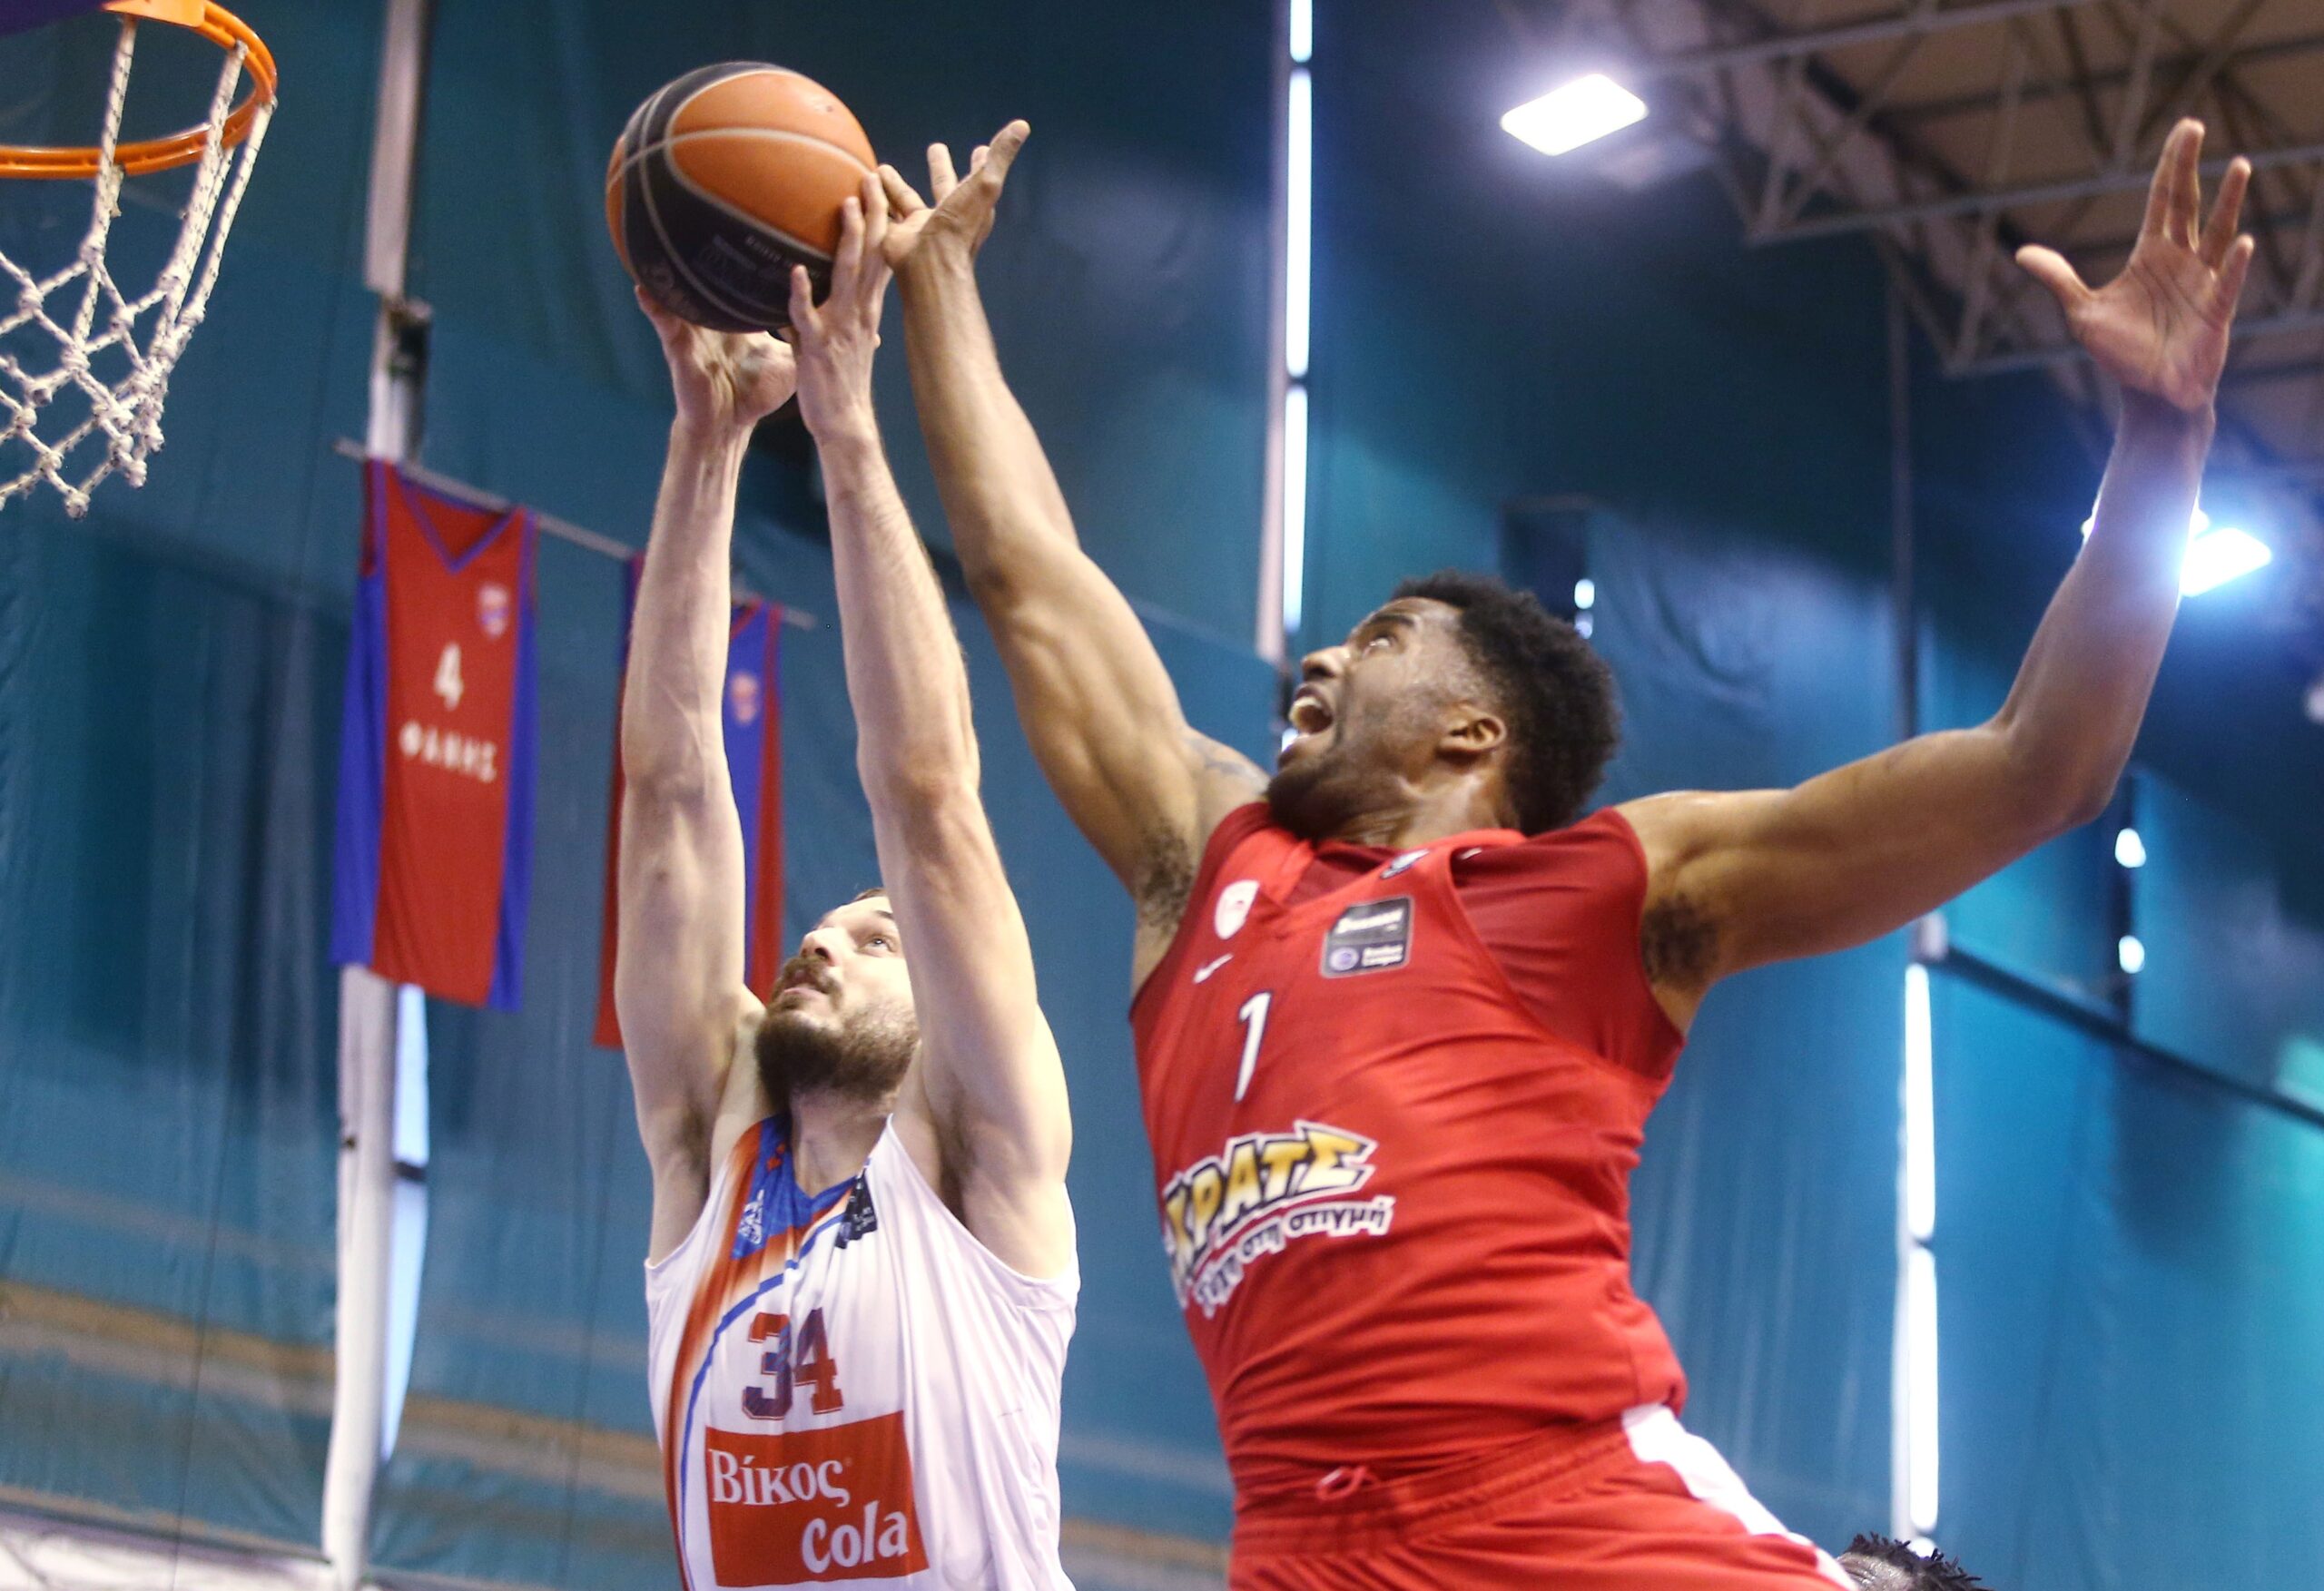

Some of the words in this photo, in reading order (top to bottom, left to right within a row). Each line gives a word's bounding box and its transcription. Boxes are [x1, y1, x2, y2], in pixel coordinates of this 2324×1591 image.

[434, 641, 465, 712] 4
[1234, 990, 1273, 1104] 1
[1287, 1198, 1391, 1234] στιγμή
[742, 1307, 843, 1420] 34
[708, 1449, 851, 1508] Βίκος
